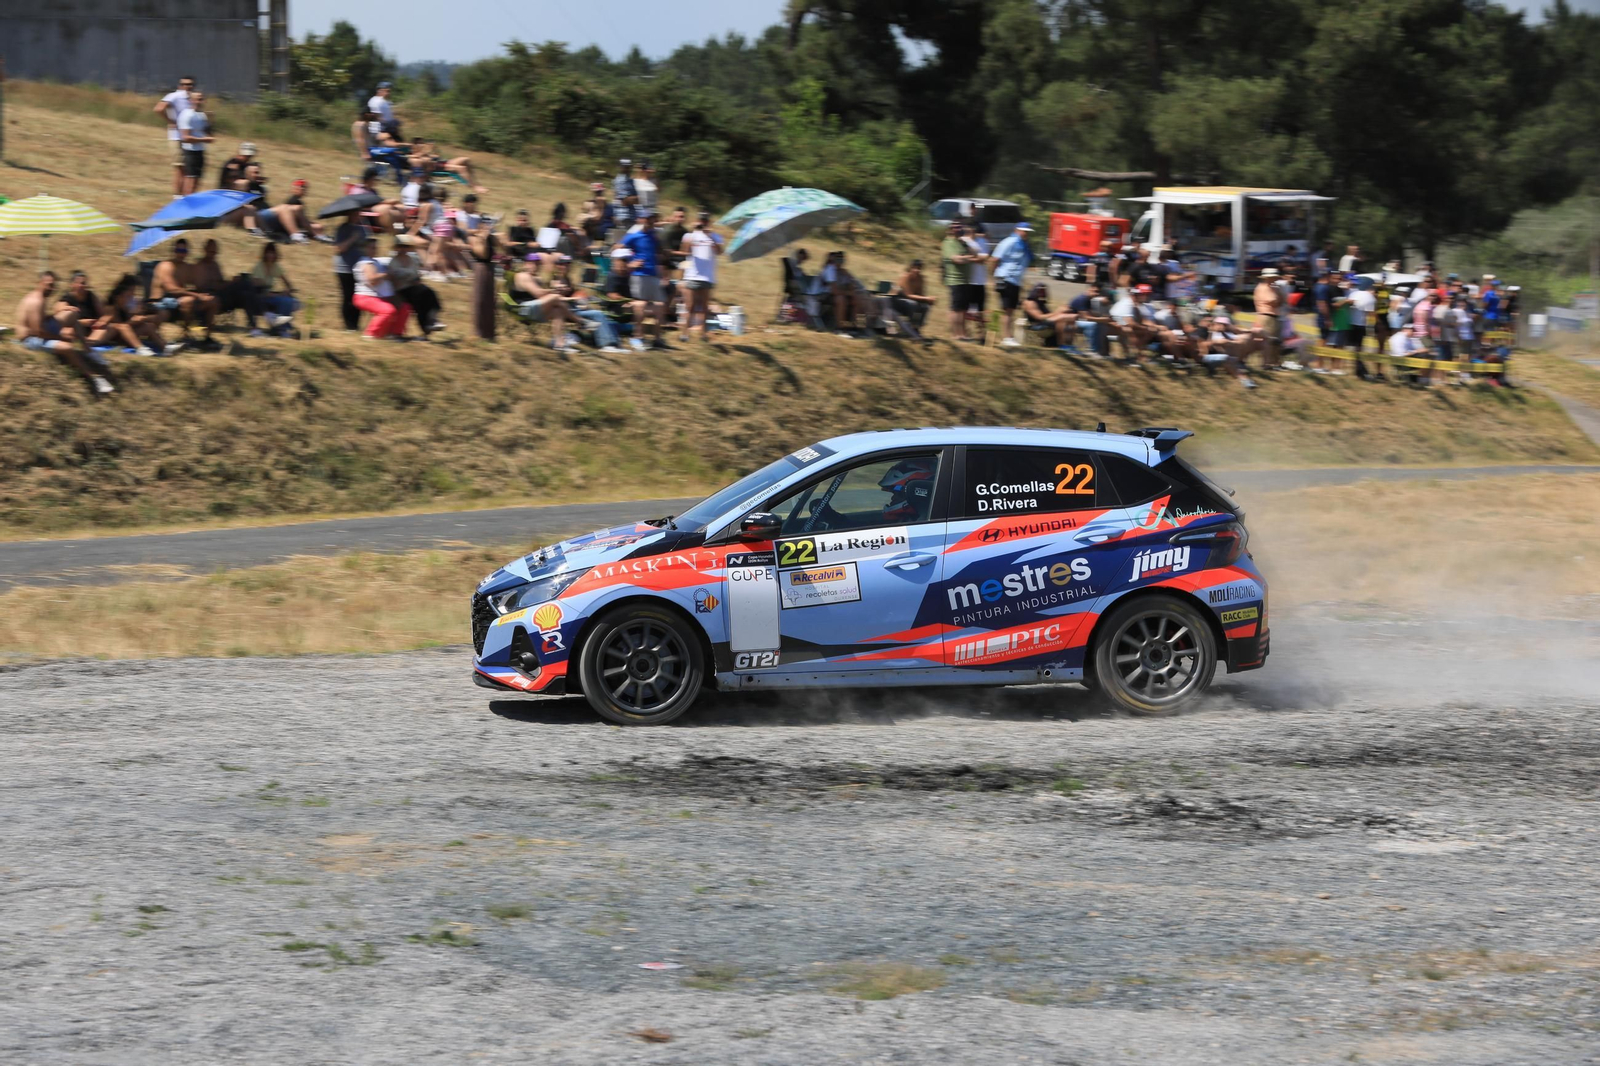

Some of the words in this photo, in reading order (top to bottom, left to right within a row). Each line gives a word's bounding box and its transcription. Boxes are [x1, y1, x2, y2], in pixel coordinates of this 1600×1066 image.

[976, 481, 1055, 496] G.Comellas
[1055, 463, 1095, 495] 22
[977, 498, 1038, 512] D.Rivera
[1008, 518, 1077, 537] HYUNDAI
[780, 540, 816, 566] 22
[820, 541, 843, 553] La
[1128, 545, 1190, 582] jimy
[801, 570, 835, 582] Recalvi
[947, 557, 1092, 611] mestres
[805, 589, 838, 599] recoletas
[953, 605, 1012, 626] PINTURA
[1016, 585, 1097, 611] INDUSTRIAL
[1222, 611, 1242, 622] RACC
[1011, 623, 1060, 649] PTC
